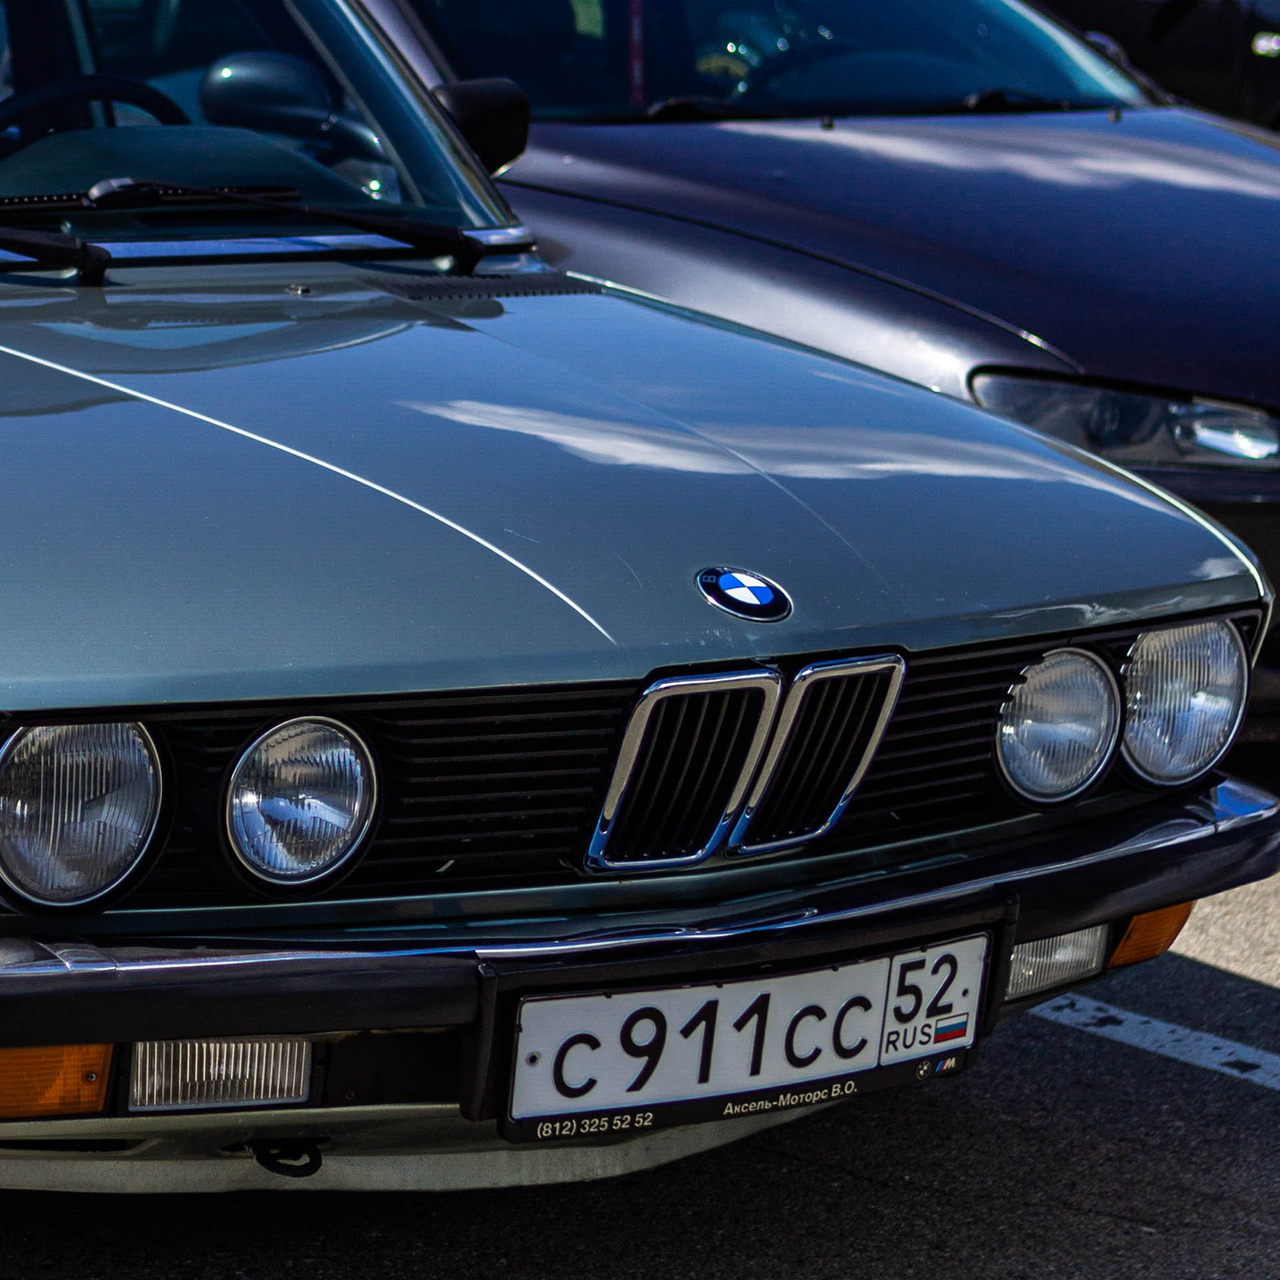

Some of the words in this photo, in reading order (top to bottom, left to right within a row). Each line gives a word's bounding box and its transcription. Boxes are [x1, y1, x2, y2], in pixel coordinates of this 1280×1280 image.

[892, 953, 959, 1025] 52
[885, 1023, 933, 1054] RUS
[722, 1088, 829, 1116] Аксель-Моторс
[536, 1119, 577, 1139] (812)
[580, 1117, 609, 1134] 325
[612, 1114, 631, 1129] 52
[634, 1112, 654, 1127] 52
